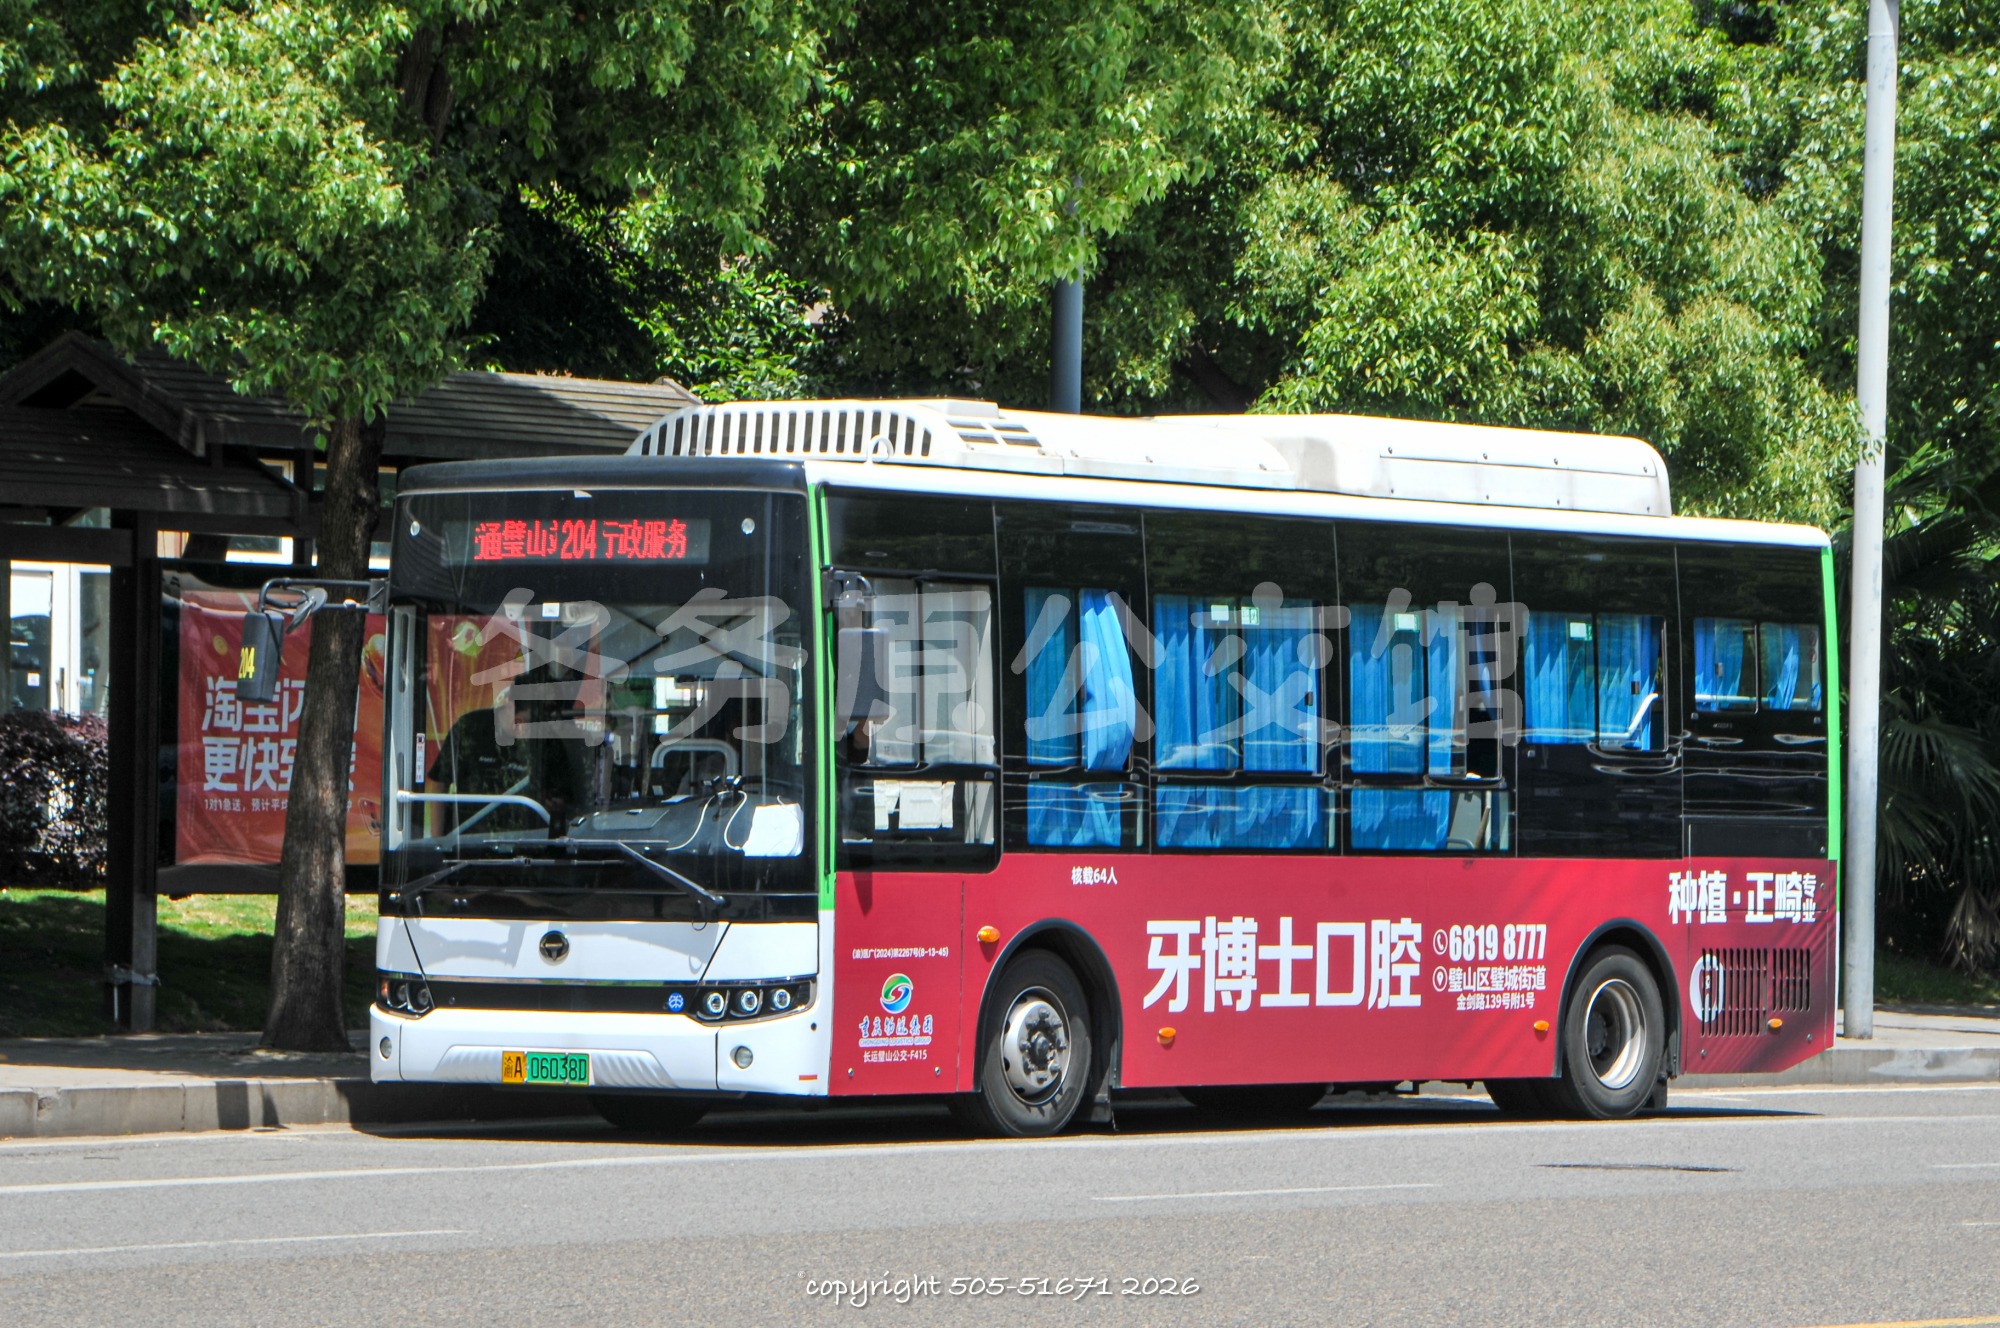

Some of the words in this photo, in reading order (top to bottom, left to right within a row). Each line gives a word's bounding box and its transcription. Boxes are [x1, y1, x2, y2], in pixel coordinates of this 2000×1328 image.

[561, 519, 597, 559] 204
[238, 647, 256, 679] 204
[1071, 865, 1118, 885] 核载64人
[1668, 870, 1802, 924] 种植·正畸
[1802, 873, 1817, 923] 专业
[1449, 924, 1499, 961] 6819
[1503, 923, 1547, 960] 8777
[1143, 915, 1422, 1013] 牙博士口腔
[1448, 965, 1546, 992] 璧山区璧城街道
[1456, 992, 1535, 1011] 金剑路139号附1号
